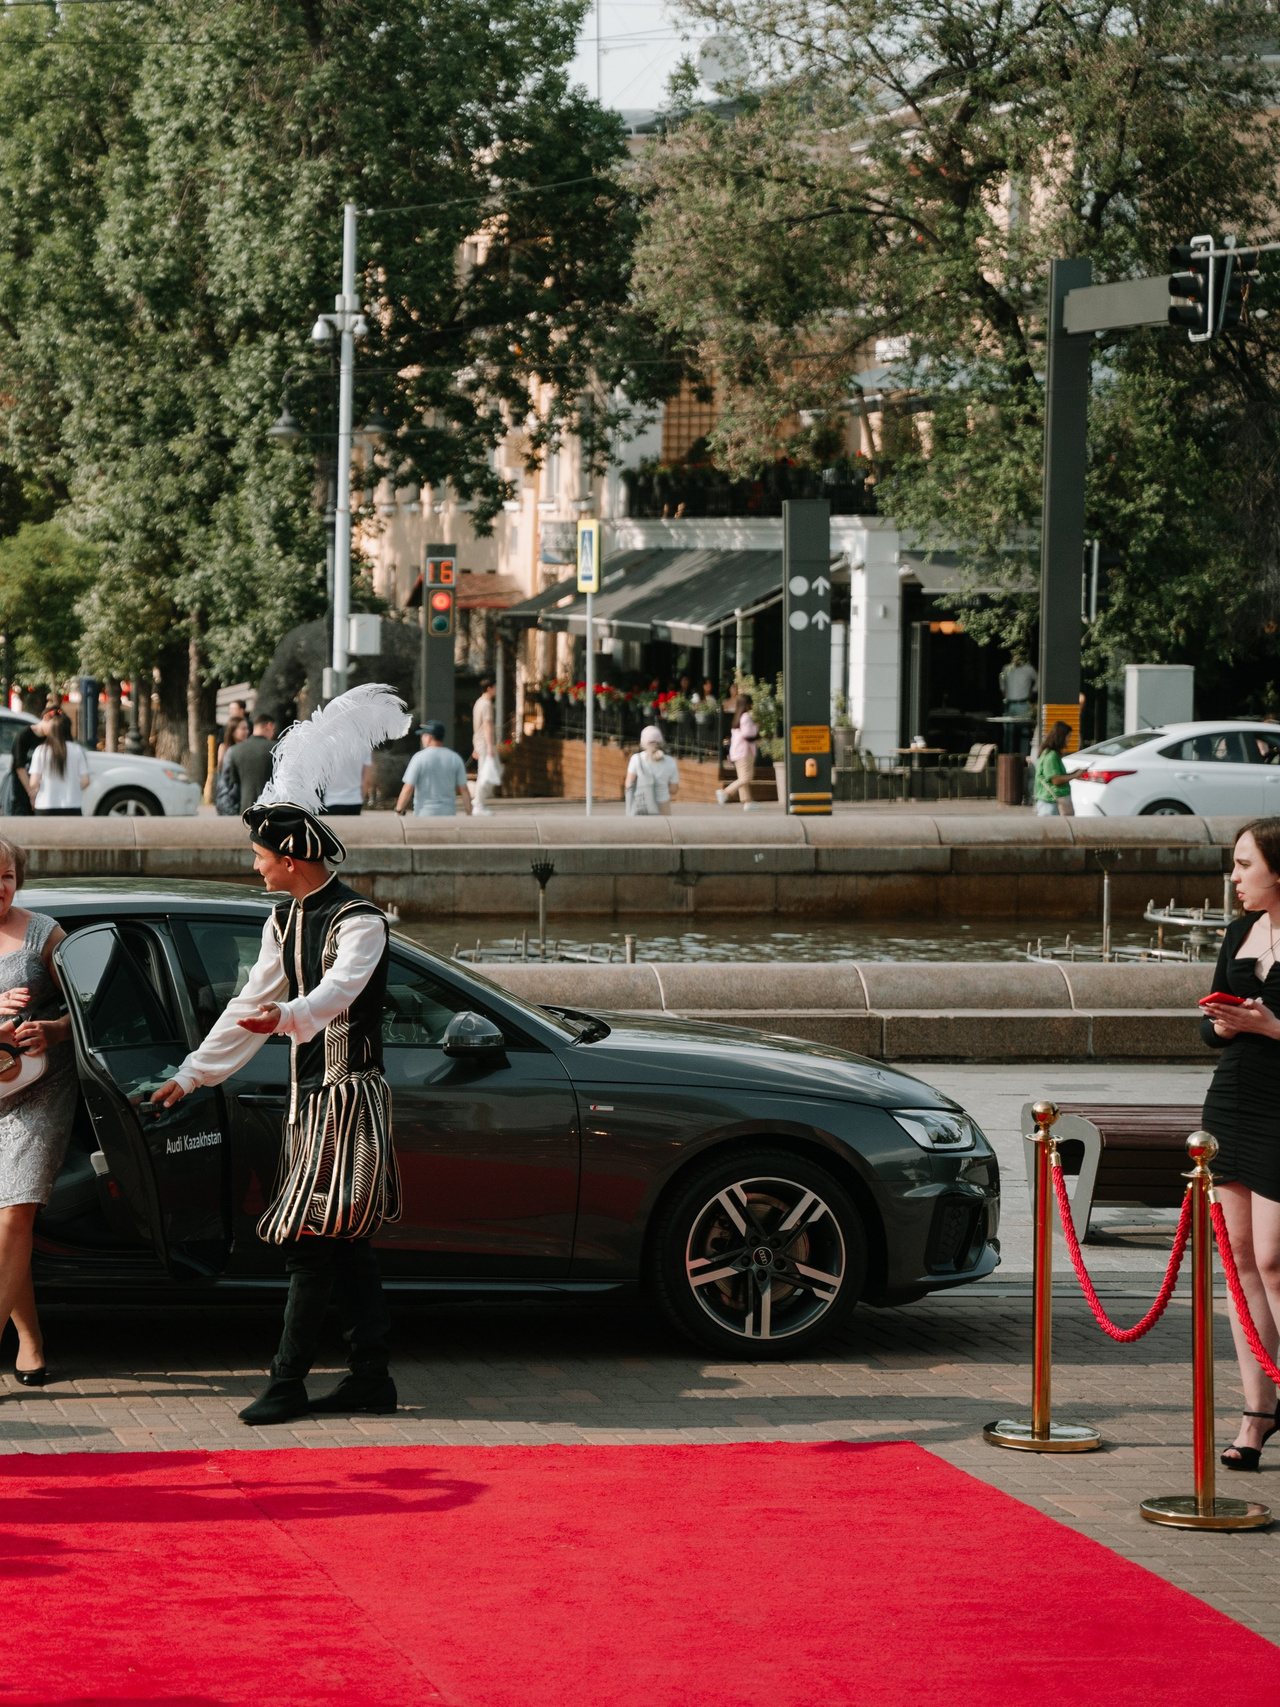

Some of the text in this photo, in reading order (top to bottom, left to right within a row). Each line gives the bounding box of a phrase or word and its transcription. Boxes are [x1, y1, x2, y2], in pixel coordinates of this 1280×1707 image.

[429, 560, 453, 584] 16
[166, 1131, 222, 1155] Audi Kazakhstan
